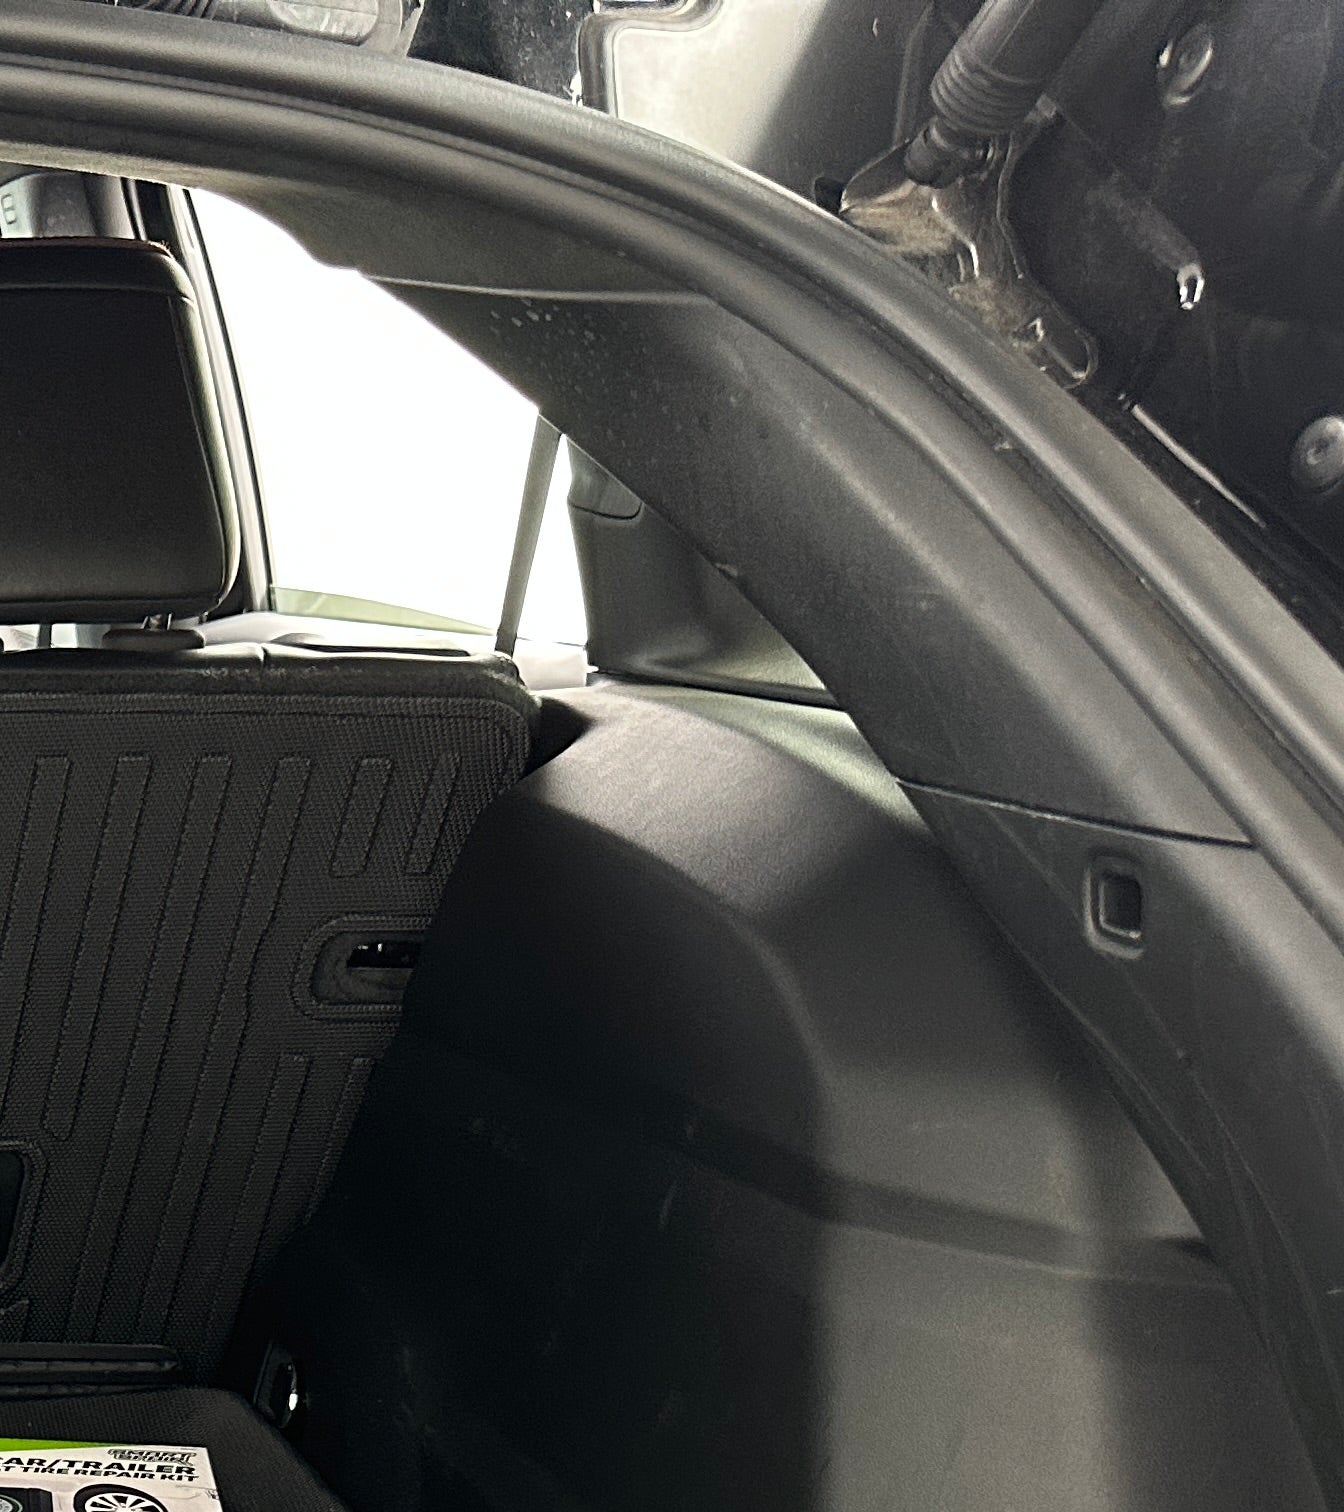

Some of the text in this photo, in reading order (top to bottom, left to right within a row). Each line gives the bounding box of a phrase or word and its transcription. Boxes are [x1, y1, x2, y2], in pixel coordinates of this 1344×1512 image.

[20, 1466, 69, 1475] TIRE
[73, 1468, 155, 1479] REPAIR
[161, 1474, 199, 1482] KIT
